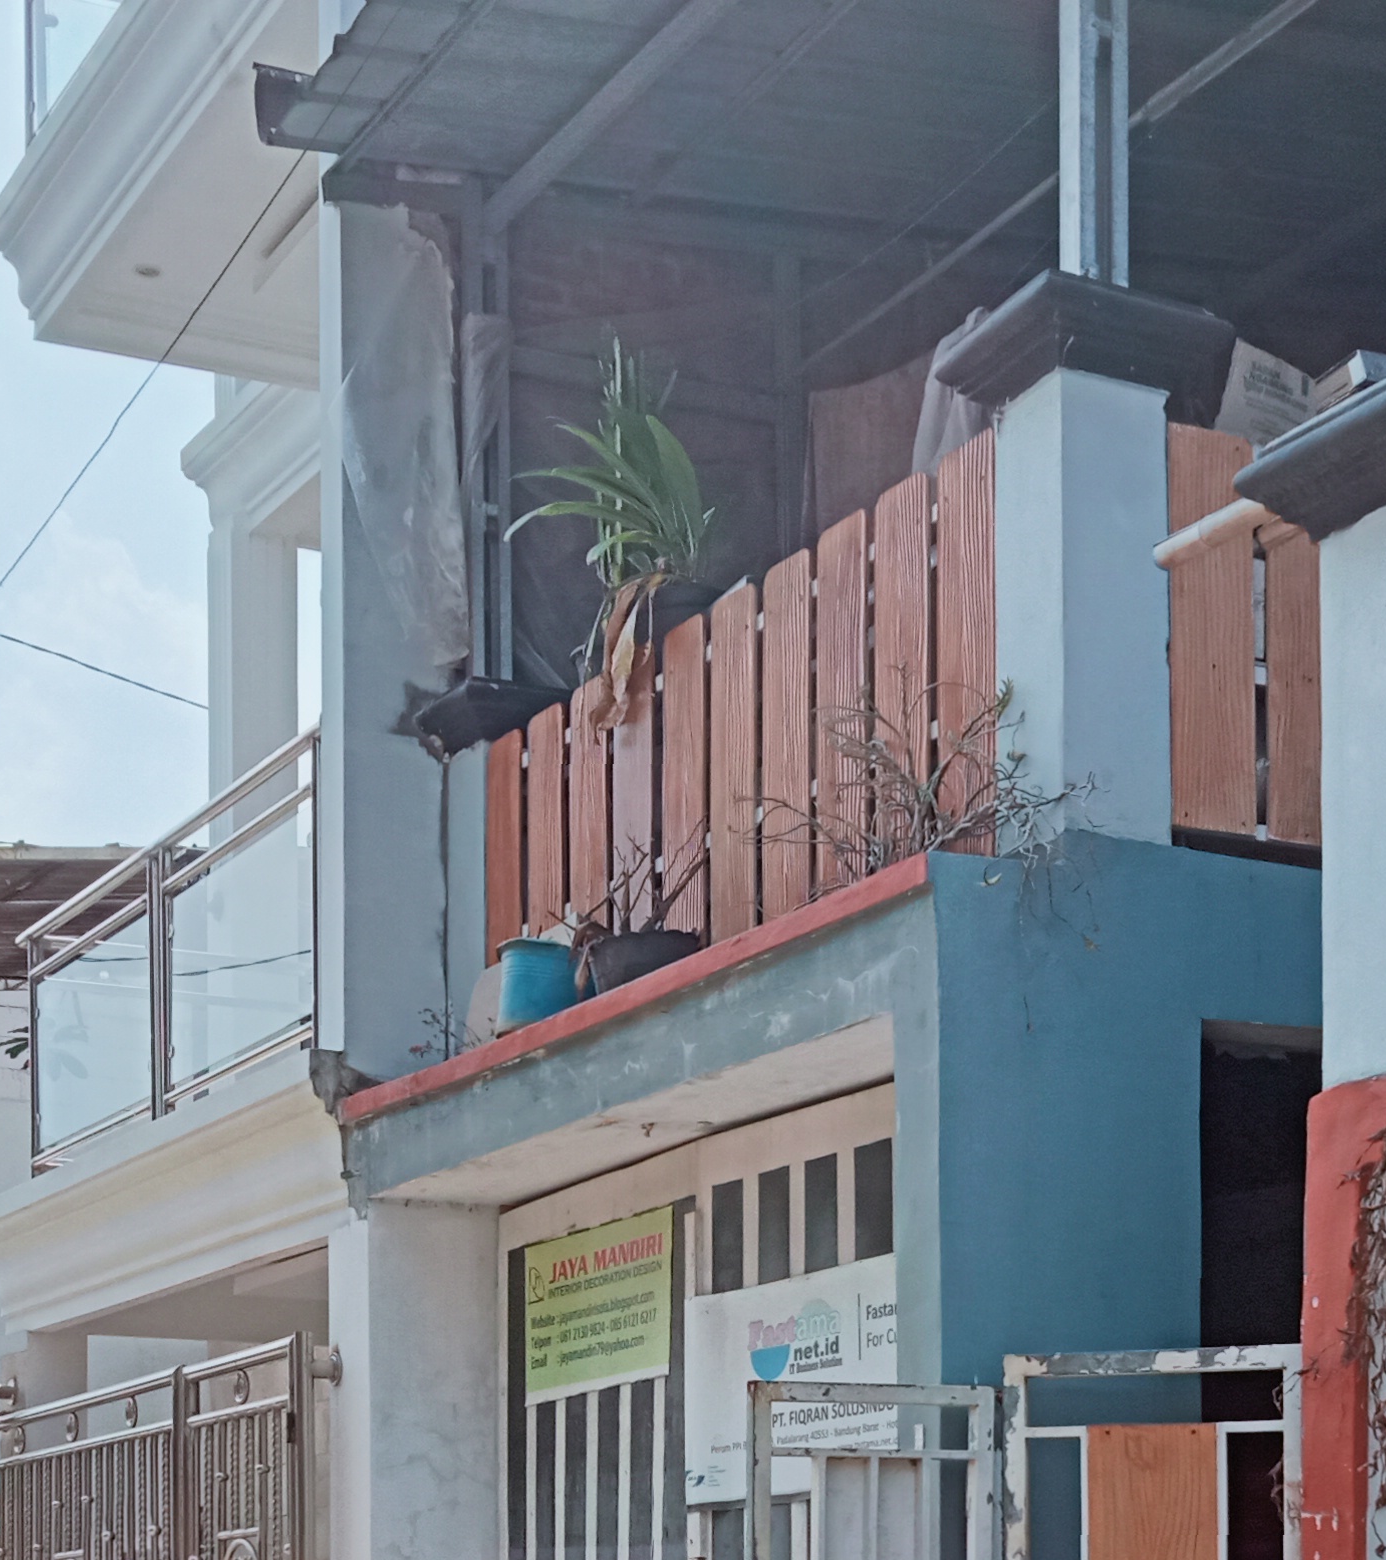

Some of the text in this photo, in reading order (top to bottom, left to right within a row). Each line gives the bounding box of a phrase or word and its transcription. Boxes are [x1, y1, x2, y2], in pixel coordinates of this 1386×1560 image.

[549, 1233, 663, 1284] JAYA MANDIRI
[548, 1281, 583, 1299] INTERIOR
[584, 1269, 631, 1290] DECORATION
[633, 1260, 662, 1276] DESIGN
[747, 1310, 842, 1350] Fastama
[866, 1332, 884, 1348] For
[794, 1335, 839, 1361] net.id
[772, 1412, 786, 1428] PT.
[789, 1406, 829, 1426] FIQRAN
